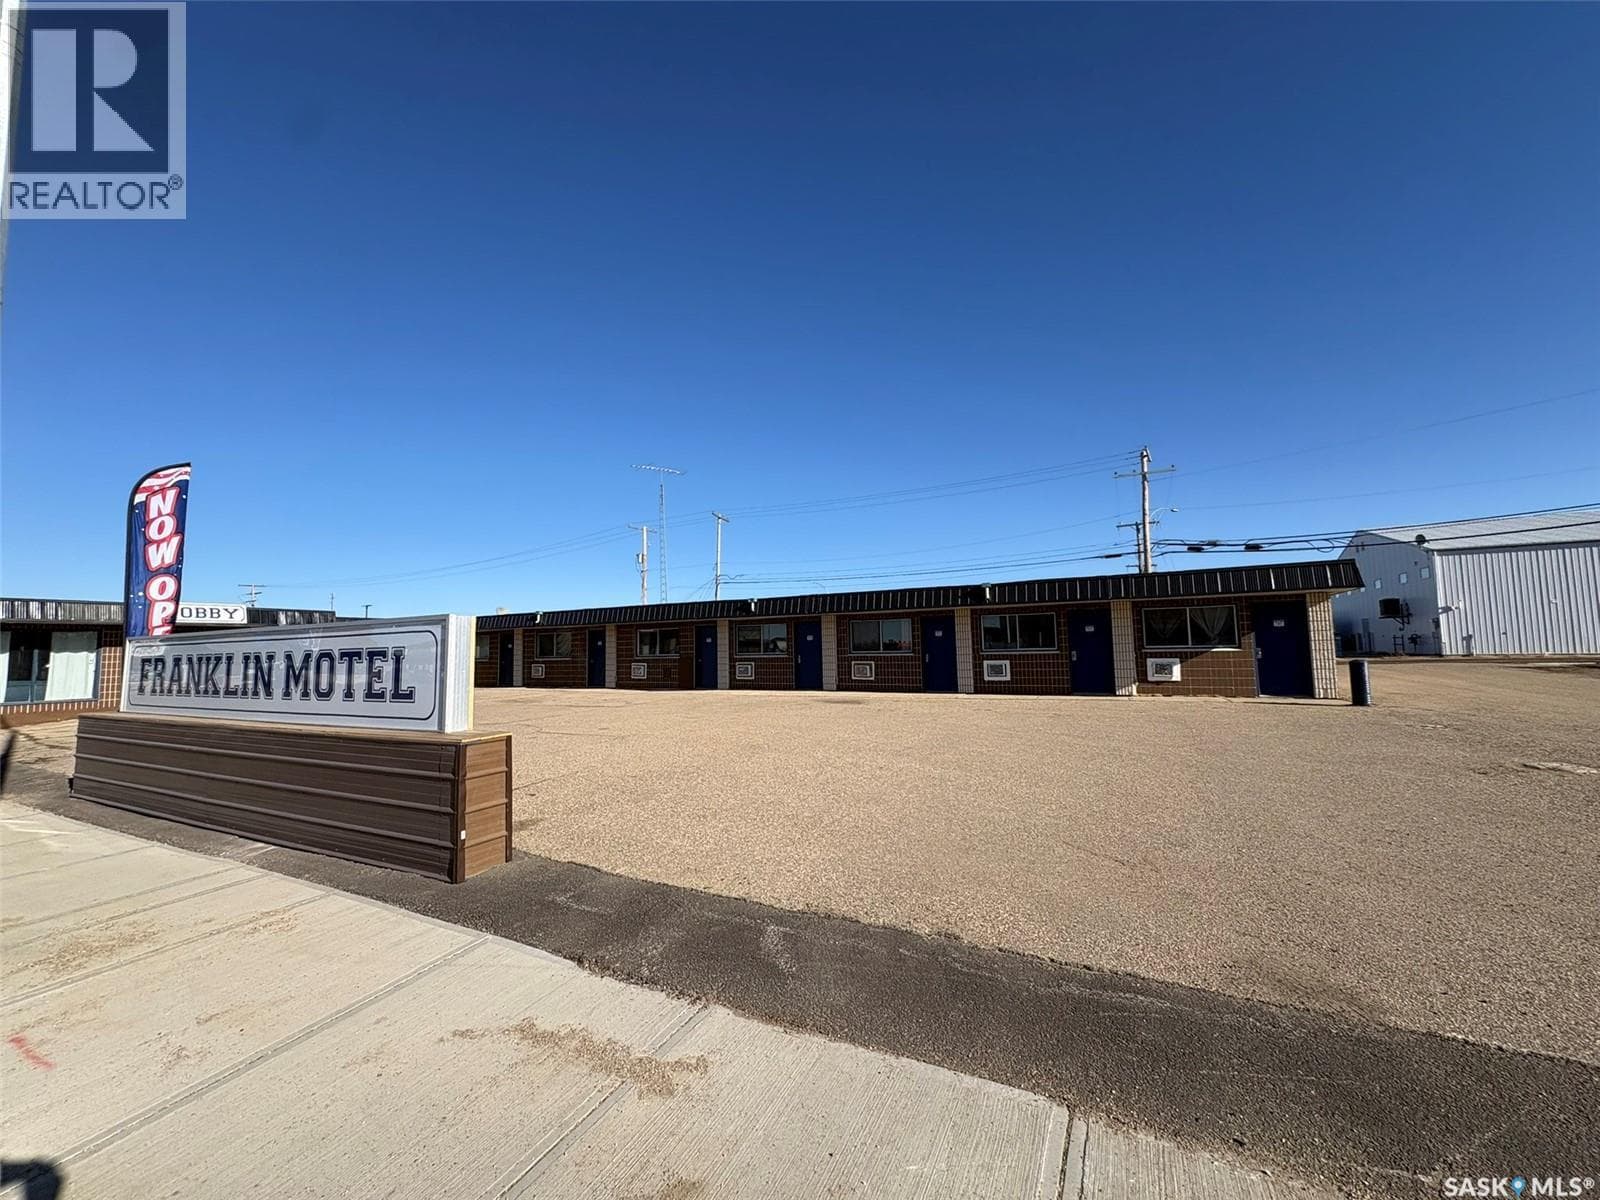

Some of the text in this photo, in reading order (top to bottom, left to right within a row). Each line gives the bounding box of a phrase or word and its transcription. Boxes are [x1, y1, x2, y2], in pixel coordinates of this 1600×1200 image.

[145, 487, 183, 636] NOW OP
[180, 606, 239, 619] OBBY
[137, 646, 416, 704] FRANKLIN MOTEL
